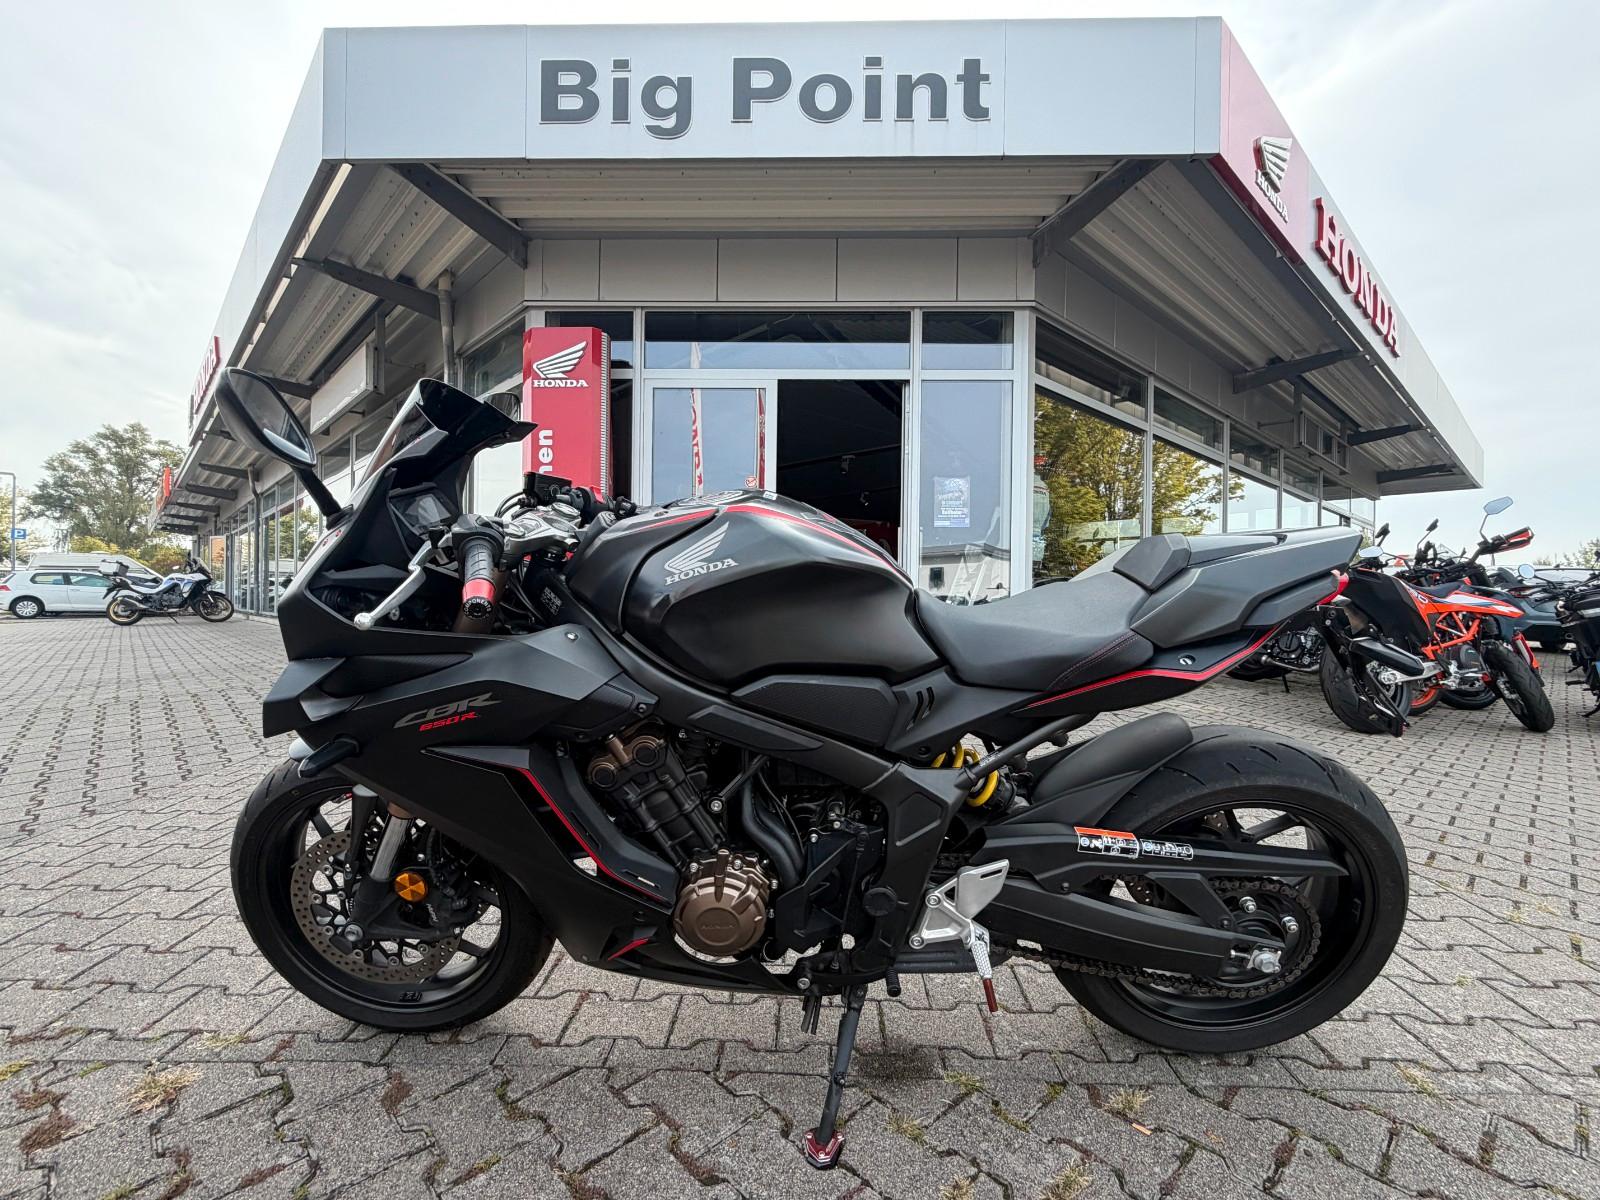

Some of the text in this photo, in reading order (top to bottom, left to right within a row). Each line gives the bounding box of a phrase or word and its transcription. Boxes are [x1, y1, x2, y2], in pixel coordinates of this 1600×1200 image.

[540, 57, 991, 139] Big Point
[1255, 169, 1289, 223] HONDA
[1313, 197, 1400, 358] HONDA
[533, 379, 589, 388] HONDA
[14, 529, 25, 539] P
[665, 558, 739, 586] HONDA
[393, 692, 502, 729] CBR
[419, 711, 478, 732] 650R
